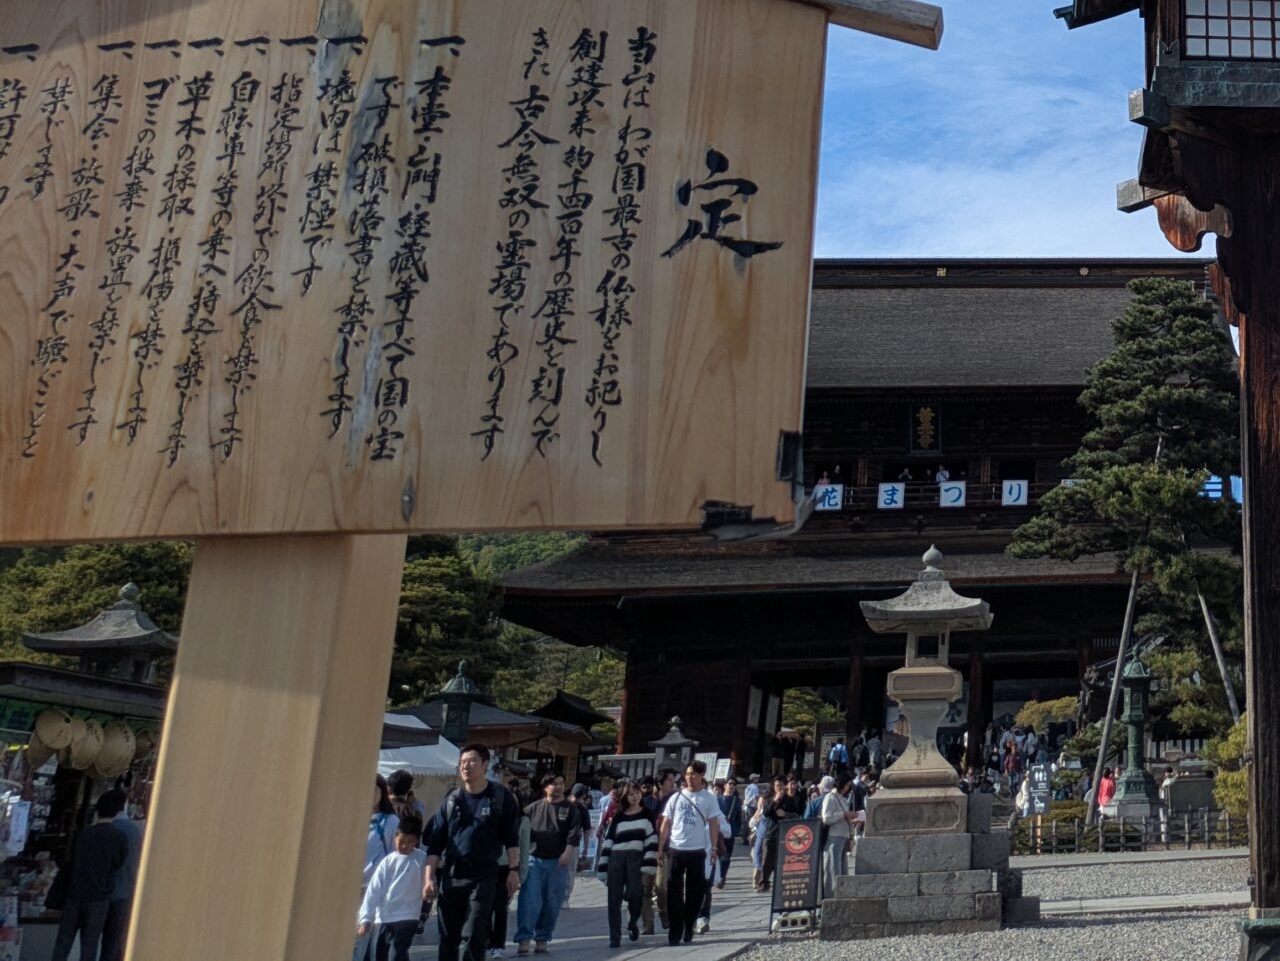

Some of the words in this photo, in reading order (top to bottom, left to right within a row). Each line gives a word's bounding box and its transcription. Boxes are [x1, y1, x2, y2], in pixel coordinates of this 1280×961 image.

[24, 76, 76, 202] 禁じます
[660, 148, 784, 258] 定
